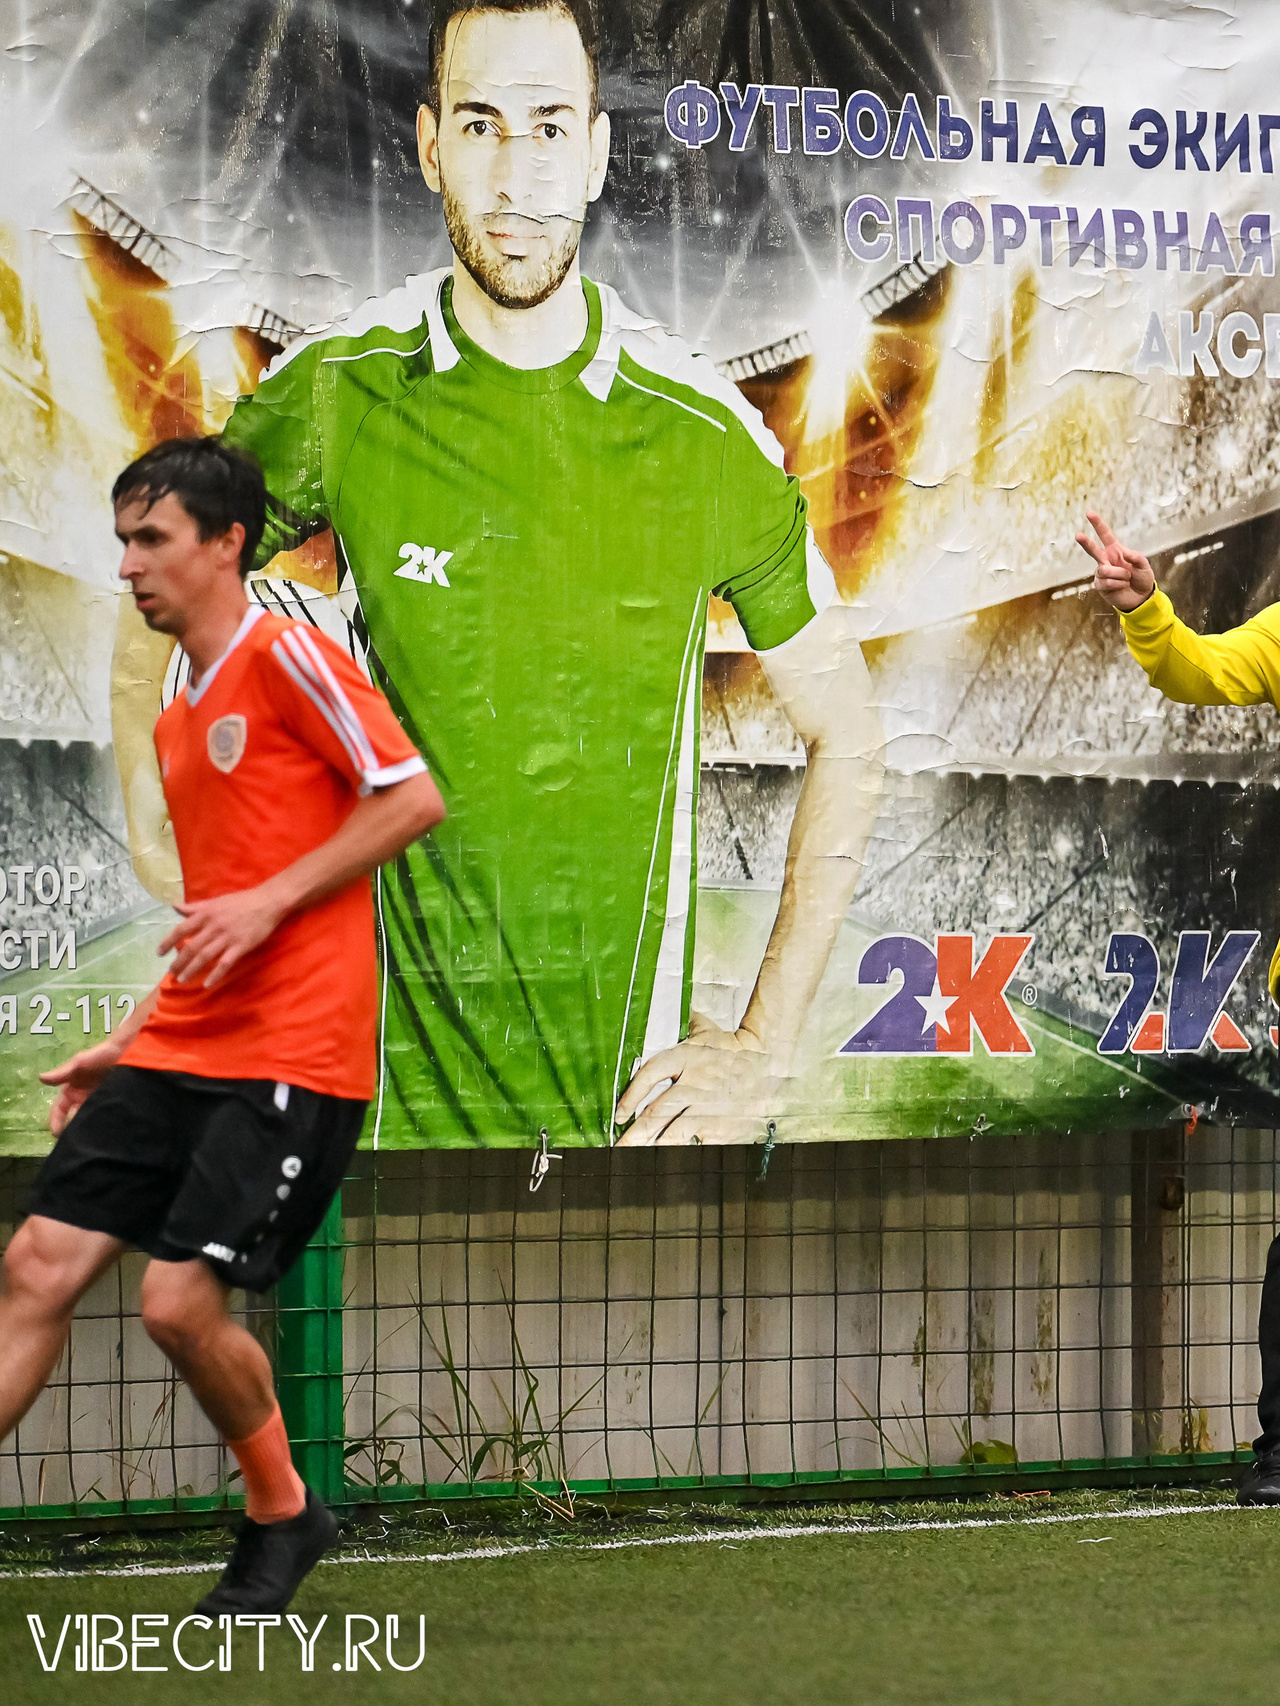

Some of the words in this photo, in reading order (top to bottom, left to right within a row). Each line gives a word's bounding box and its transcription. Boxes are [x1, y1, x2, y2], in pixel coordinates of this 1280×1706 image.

[664, 79, 1106, 170] ФУТБОЛЬНАЯ
[843, 193, 1274, 277] СПОРТИВНАЯ
[393, 542, 454, 588] 2K
